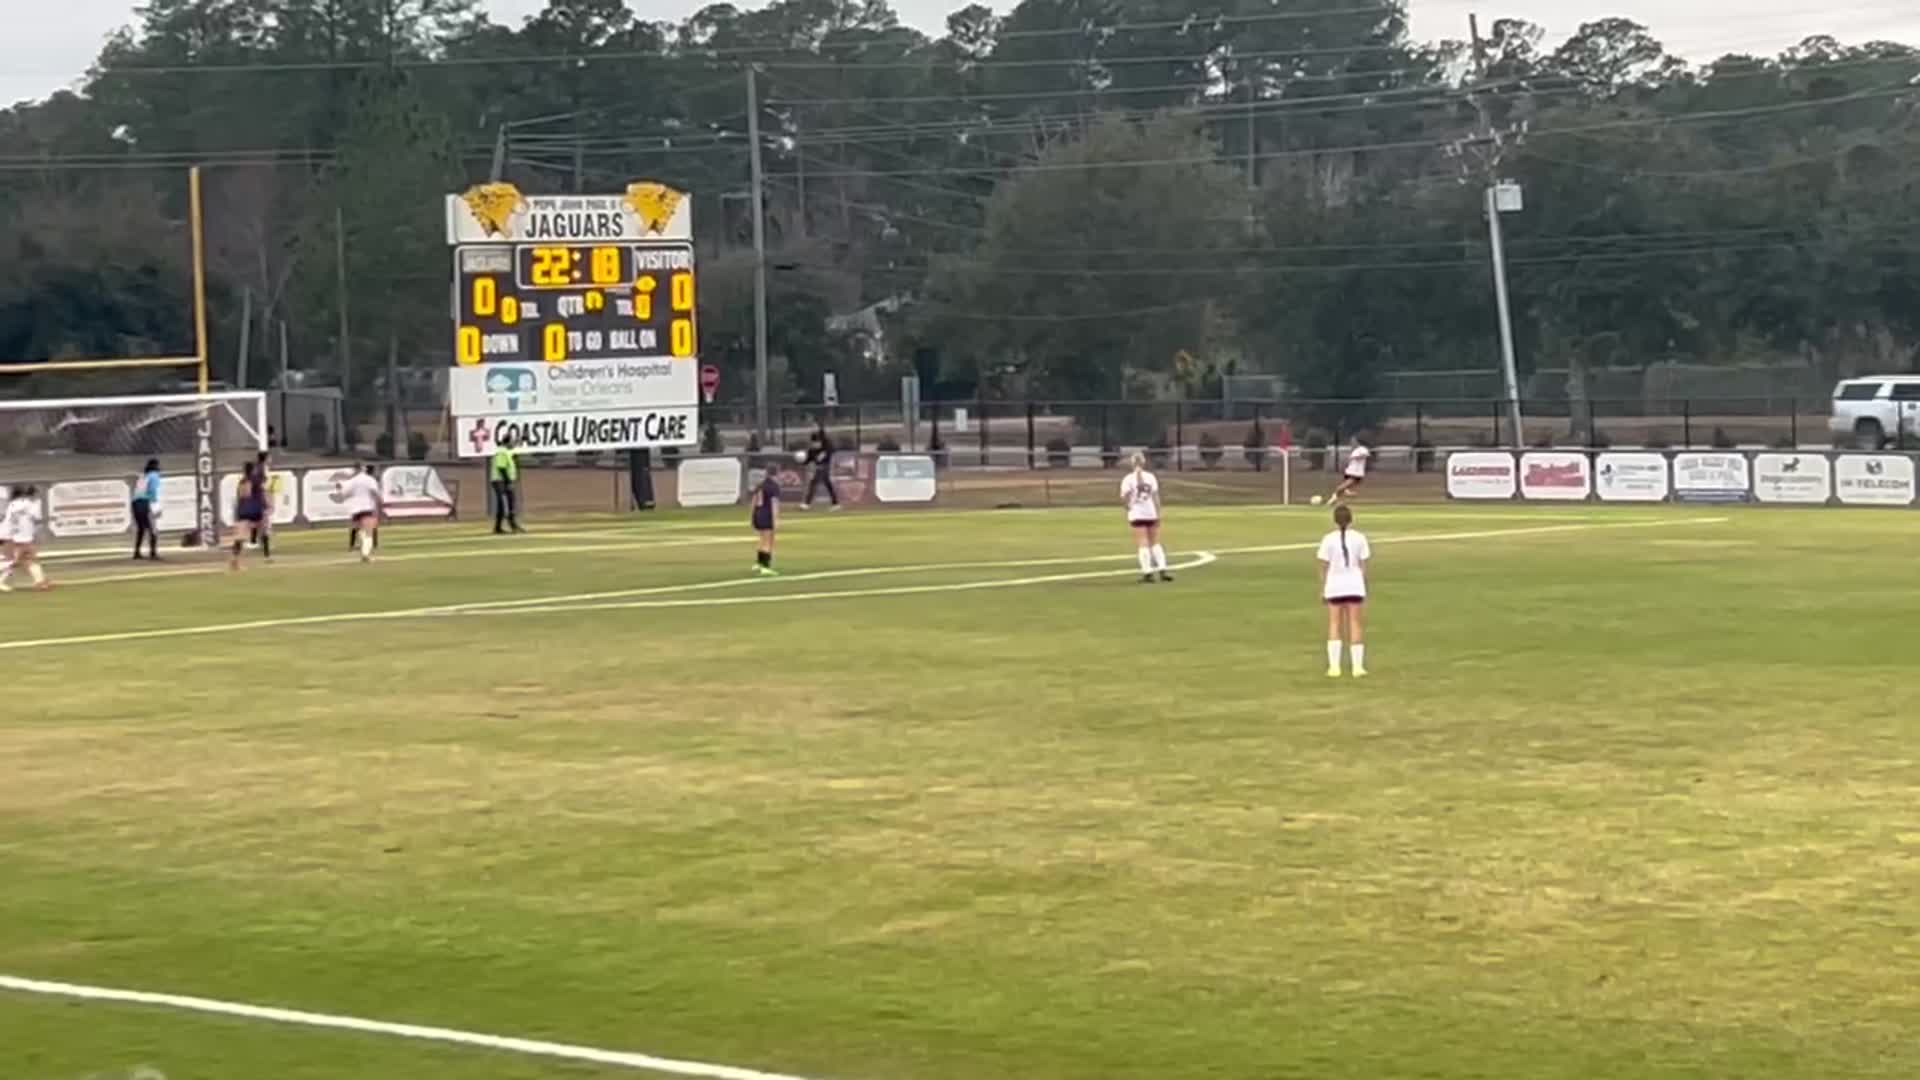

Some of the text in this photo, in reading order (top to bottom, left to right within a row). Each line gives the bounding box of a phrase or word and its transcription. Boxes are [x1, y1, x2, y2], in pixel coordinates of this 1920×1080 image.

[525, 213, 624, 239] JAGUARS
[637, 250, 690, 270] VISITOR
[473, 277, 496, 316] 0
[671, 273, 694, 311] 0
[458, 326, 481, 364] 0
[482, 335, 519, 353] DOWN
[544, 324, 566, 361] 0
[568, 331, 602, 351] TO GO
[609, 330, 656, 350] BALL ON
[671, 319, 693, 357] 0
[548, 361, 672, 380] Children's Hospital
[582, 381, 633, 396] Orleans
[494, 413, 687, 447] COASTAL URGENT CARE
[197, 419, 215, 546] JAGUARS
